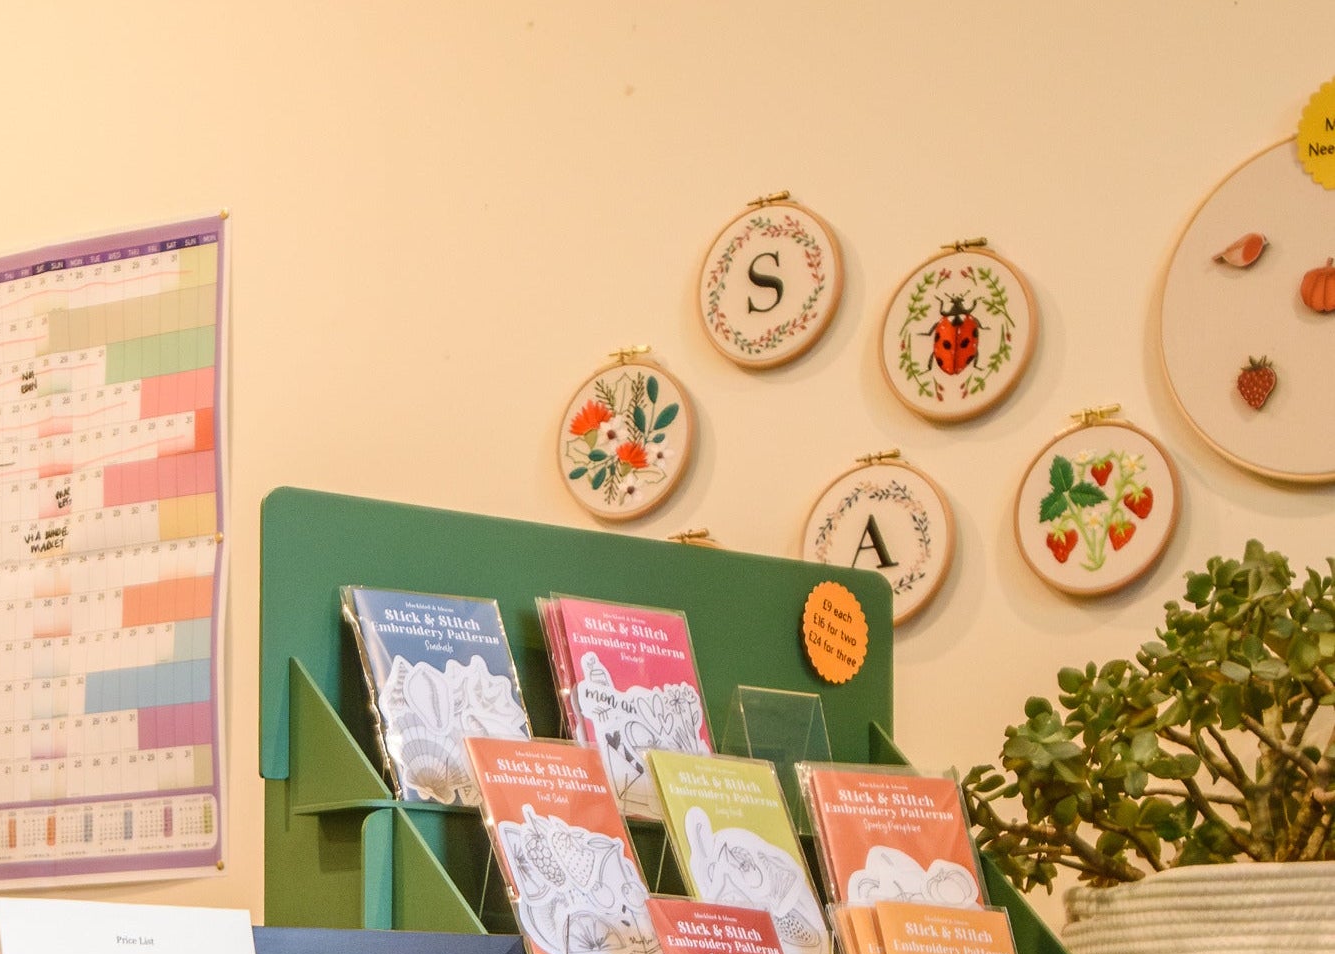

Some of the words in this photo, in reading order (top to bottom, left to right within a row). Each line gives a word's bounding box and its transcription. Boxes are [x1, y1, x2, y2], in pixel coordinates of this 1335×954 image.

[747, 251, 784, 314] S
[853, 514, 898, 569] A
[385, 608, 421, 624] Stick
[425, 613, 435, 628] &
[438, 614, 481, 632] Stitch
[823, 599, 833, 612] £9
[833, 609, 853, 624] each
[373, 622, 444, 640] Embroidery
[447, 629, 499, 645] Patterns
[585, 617, 617, 634] Stick
[619, 624, 629, 638] &
[631, 624, 669, 642] Stitch
[813, 612, 825, 628] £16
[827, 622, 839, 636] for
[841, 630, 857, 646] two
[573, 632, 637, 653] Embroidery
[640, 642, 685, 660] Patterns
[809, 630, 822, 646] £24
[823, 640, 834, 654] for
[837, 649, 857, 667] three
[585, 688, 617, 708] mon
[497, 758, 532, 773] Stick
[535, 762, 545, 776] &
[547, 764, 588, 779] Stitch
[485, 772, 555, 790] Embroidery
[558, 778, 607, 794] Patterns
[838, 789, 873, 803] Stick
[877, 792, 889, 806] &
[892, 794, 935, 808] Stitch
[825, 802, 896, 819] Embroidery
[901, 808, 953, 820] Patterns
[117, 936, 137, 945] Price
[139, 937, 154, 946] List
[677, 921, 711, 936] Stick
[713, 924, 723, 939] &
[725, 926, 762, 941] Stitch
[905, 922, 939, 938] Stick
[942, 926, 951, 940] &
[955, 928, 993, 943] Stitch
[667, 935, 732, 954] Embroidery
